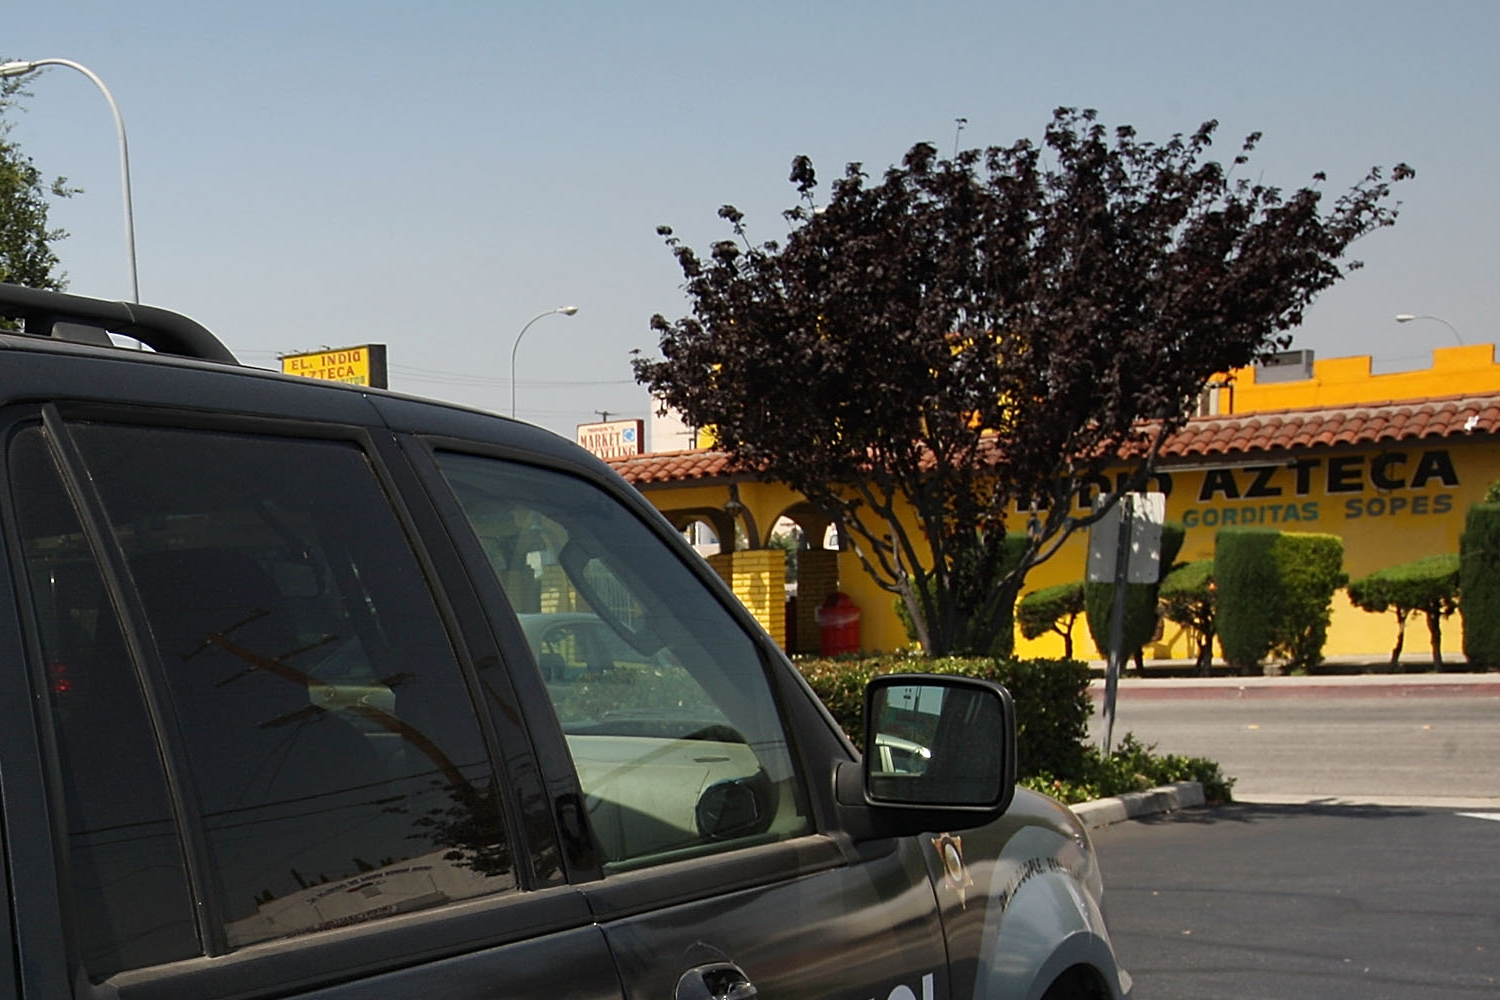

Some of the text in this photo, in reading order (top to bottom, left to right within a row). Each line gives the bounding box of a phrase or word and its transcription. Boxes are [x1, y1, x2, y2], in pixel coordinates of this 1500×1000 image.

[292, 359, 308, 371] EL
[580, 432, 621, 449] MARKET
[1198, 450, 1460, 502] AZTECA
[1182, 493, 1454, 528] GORDITAS SOPES
